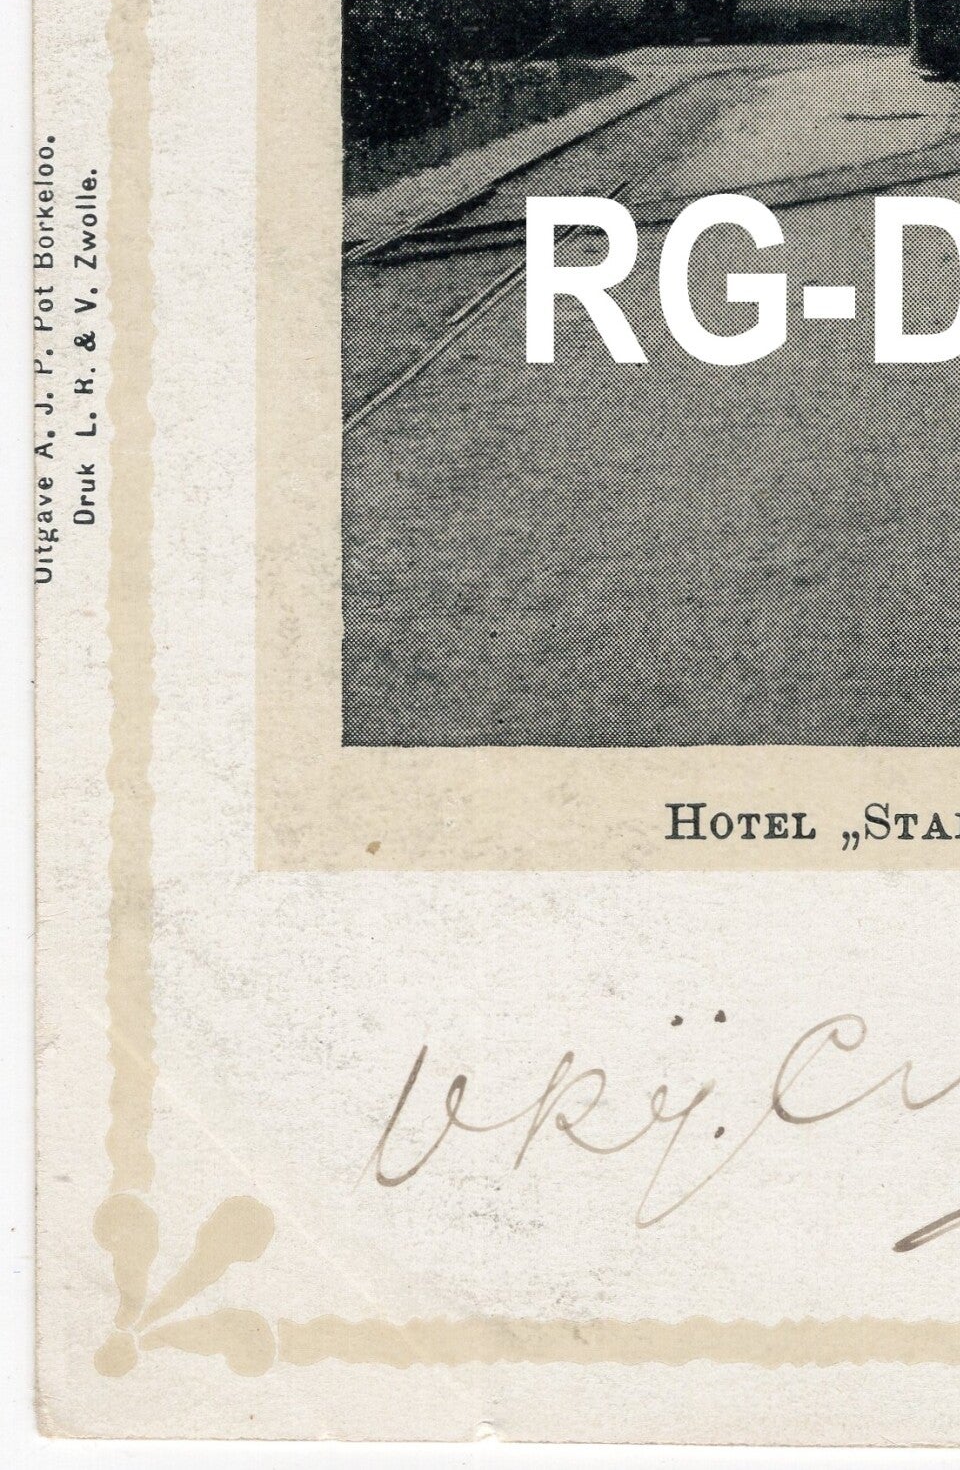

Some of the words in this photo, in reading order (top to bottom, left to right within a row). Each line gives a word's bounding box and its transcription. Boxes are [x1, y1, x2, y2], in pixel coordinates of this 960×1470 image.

[33, 136, 57, 269] Borkeloo.
[73, 169, 98, 270] Zwolle.
[33, 286, 55, 331] Pot
[73, 287, 98, 314] V.
[73, 331, 98, 352] &
[33, 349, 55, 375] P.
[33, 392, 56, 416] J.
[73, 412, 98, 437] L.
[33, 430, 56, 459] A.
[73, 464, 97, 525] Druk
[33, 476, 59, 584] Uitgave
[664, 802, 817, 841] HOTEL
